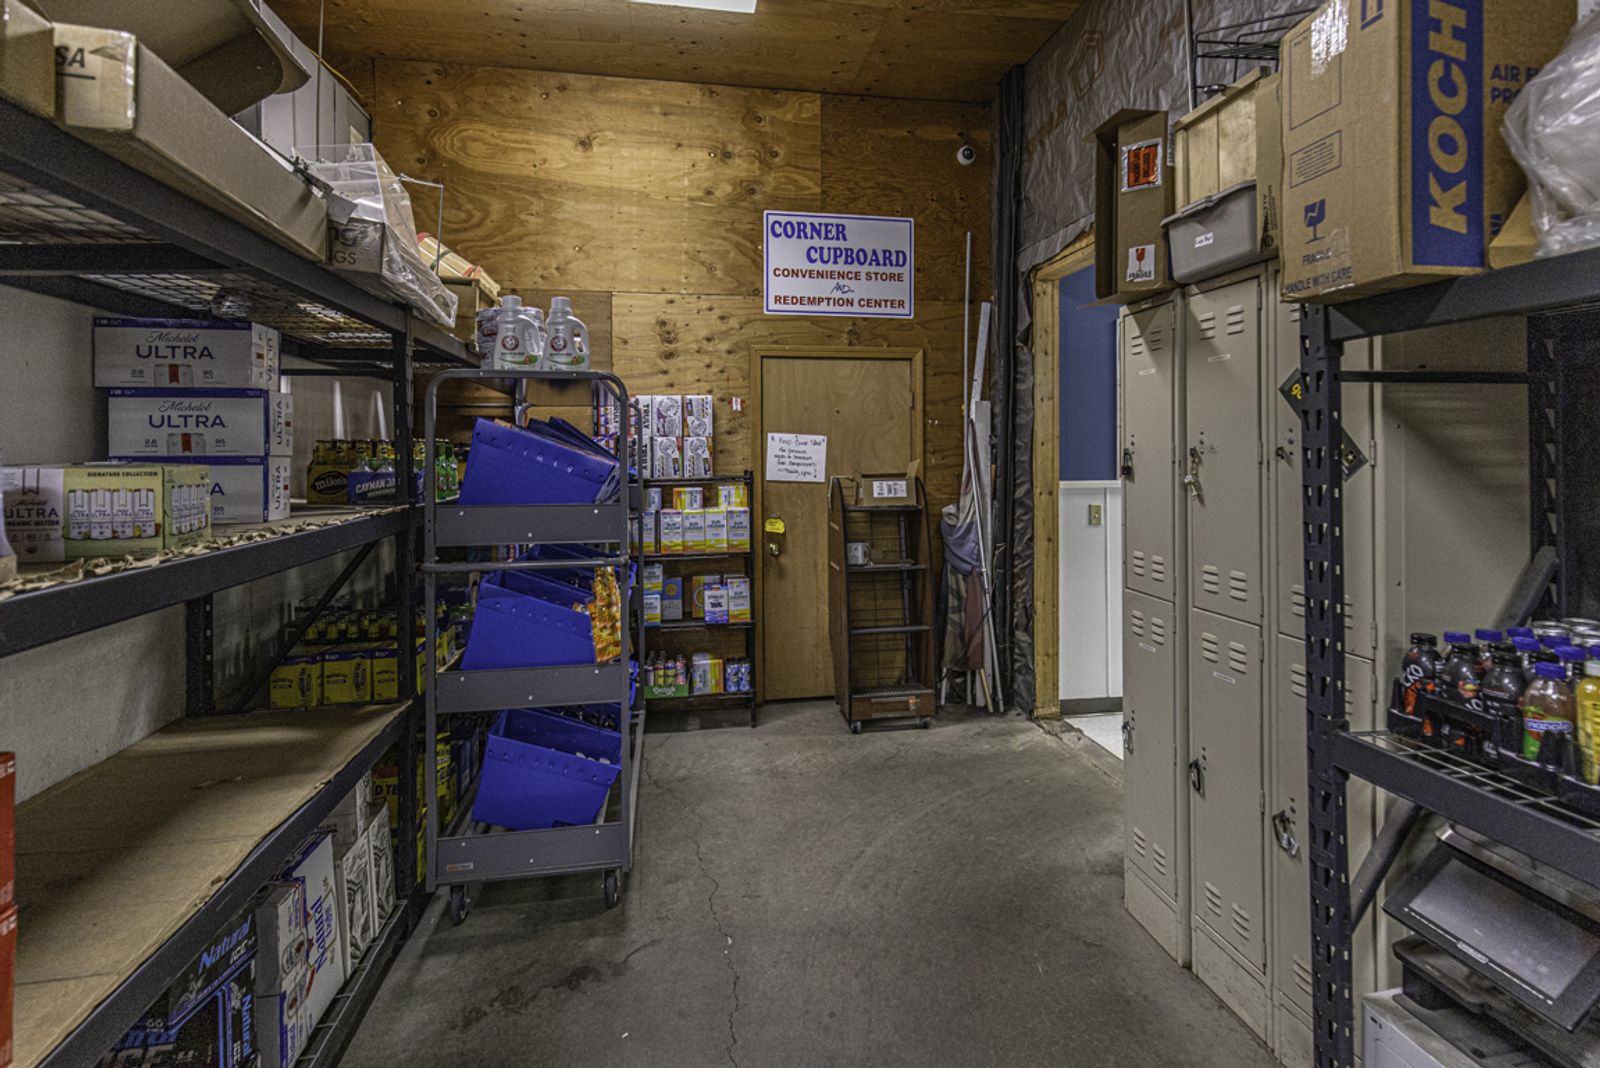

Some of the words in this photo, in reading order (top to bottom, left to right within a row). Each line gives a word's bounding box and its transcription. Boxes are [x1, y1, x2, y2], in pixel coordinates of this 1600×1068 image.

[1490, 63, 1521, 83] AIR
[1427, 0, 1468, 234] KOCH
[770, 220, 847, 242] CORNER
[806, 245, 907, 268] CUPBOARD
[773, 267, 862, 281] CONVENIENCE
[865, 271, 904, 282] STORE
[1128, 270, 1152, 280] FRAGILE
[1312, 272, 1331, 287] WITH
[1331, 266, 1353, 281] CARE
[774, 295, 854, 308] REDEMPTION
[858, 298, 906, 309] CENTER
[136, 344, 215, 360] ULTRA
[148, 414, 225, 428] ULTRA
[355, 479, 385, 494] CAYMAN
[198, 913, 253, 976] Natural
[310, 895, 328, 974] Natural
[242, 994, 252, 1058] Natural
